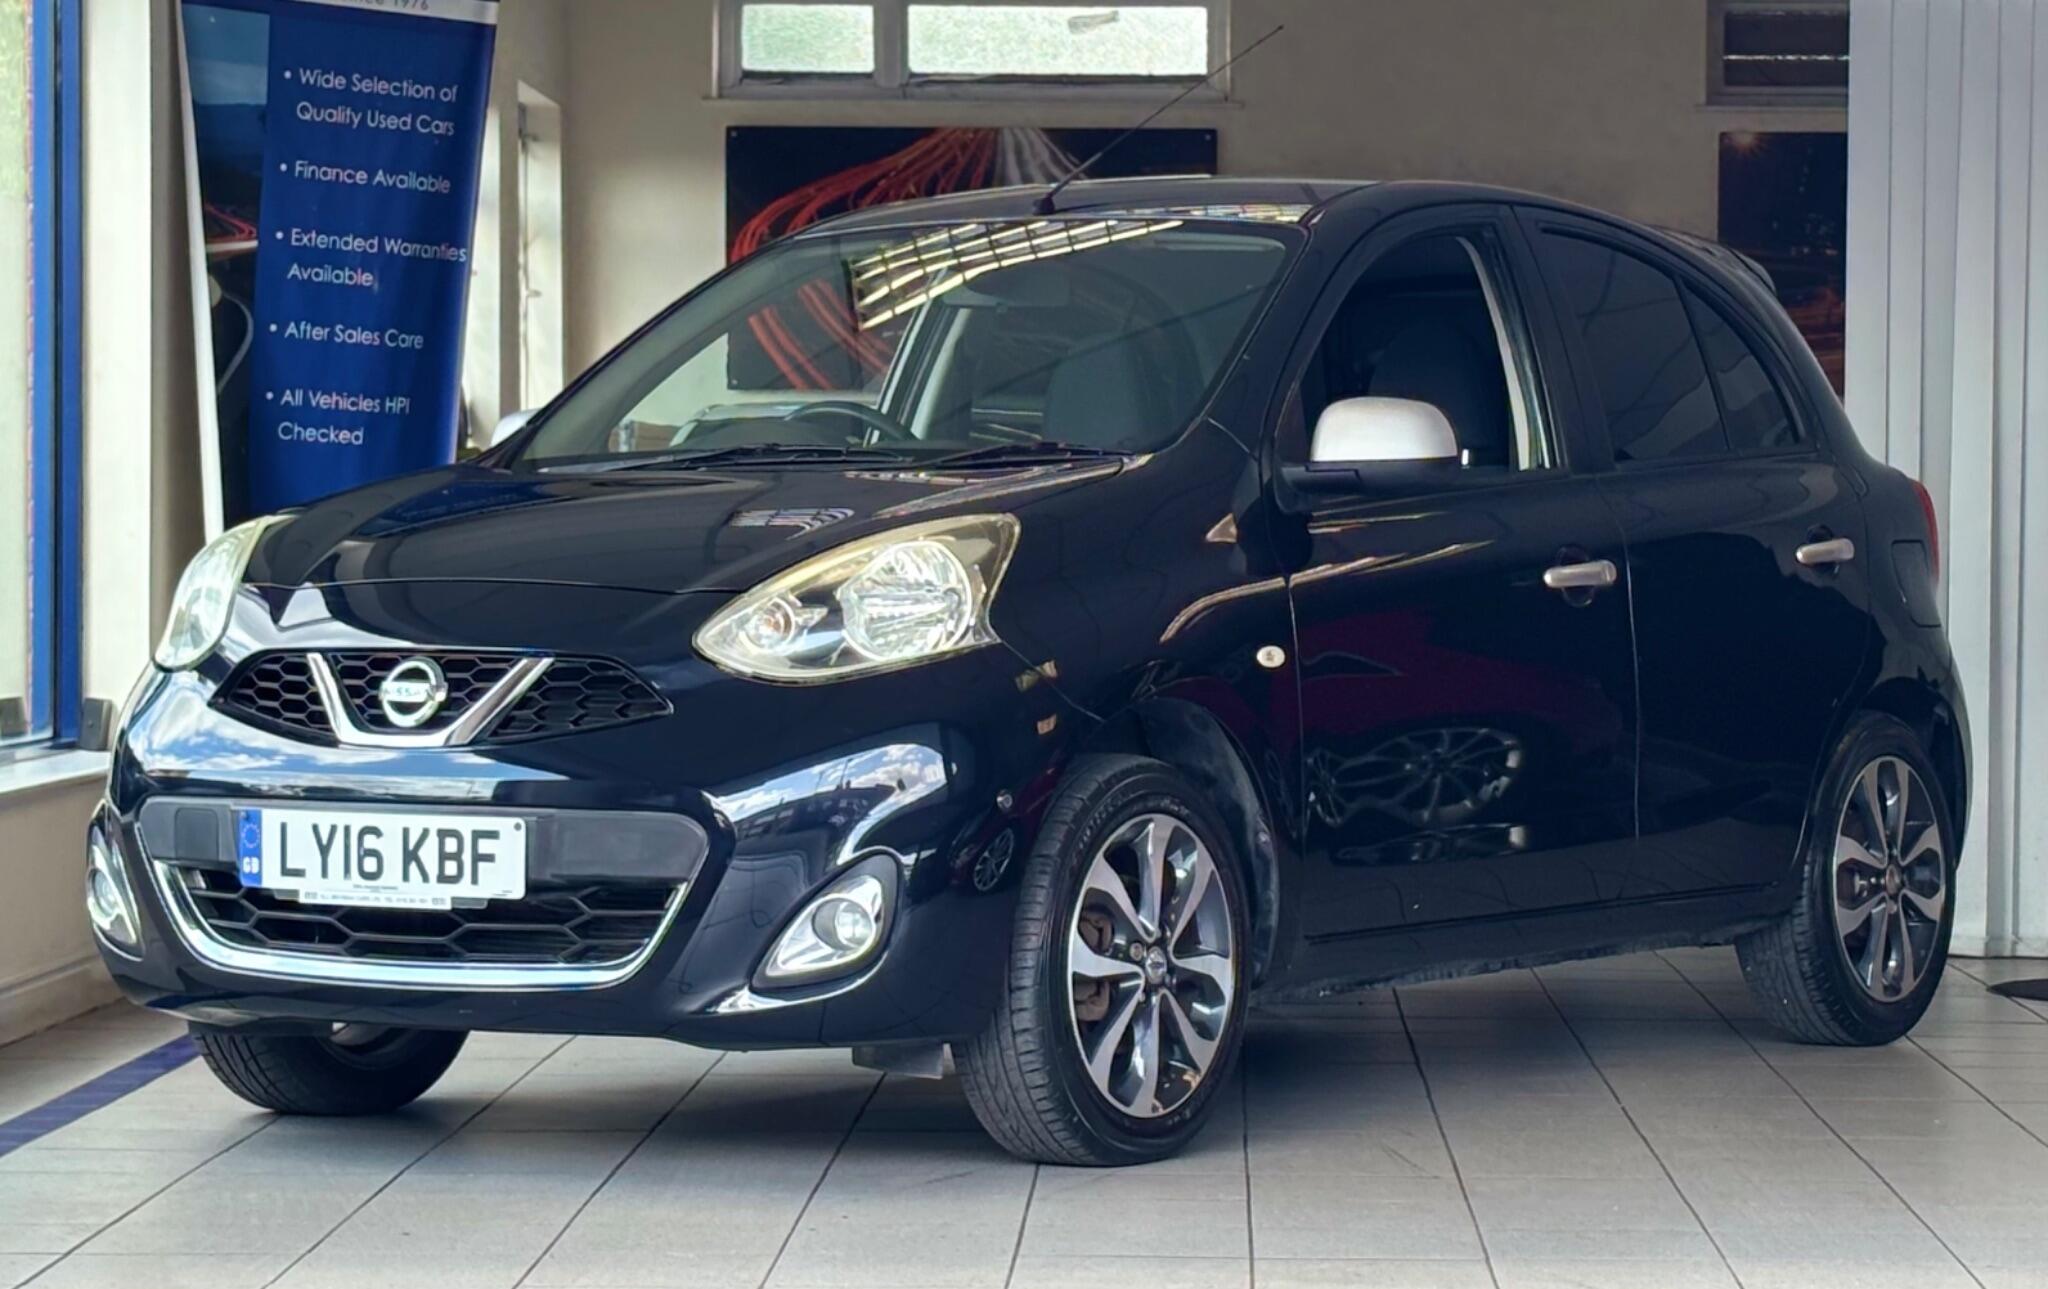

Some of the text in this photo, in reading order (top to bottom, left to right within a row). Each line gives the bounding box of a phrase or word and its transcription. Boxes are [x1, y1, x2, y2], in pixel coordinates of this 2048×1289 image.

[299, 67, 459, 103] Wide Selection of
[296, 101, 455, 136] Quality Used Cars
[294, 160, 451, 194] Finance Available
[290, 228, 468, 262] Extended Warranties
[286, 263, 374, 287] Available
[284, 321, 424, 350] After Sales Care
[280, 389, 410, 415] All Vehicles HPI
[277, 421, 364, 446] Checked
[280, 822, 384, 881] LY16
[402, 827, 500, 886] KBF
